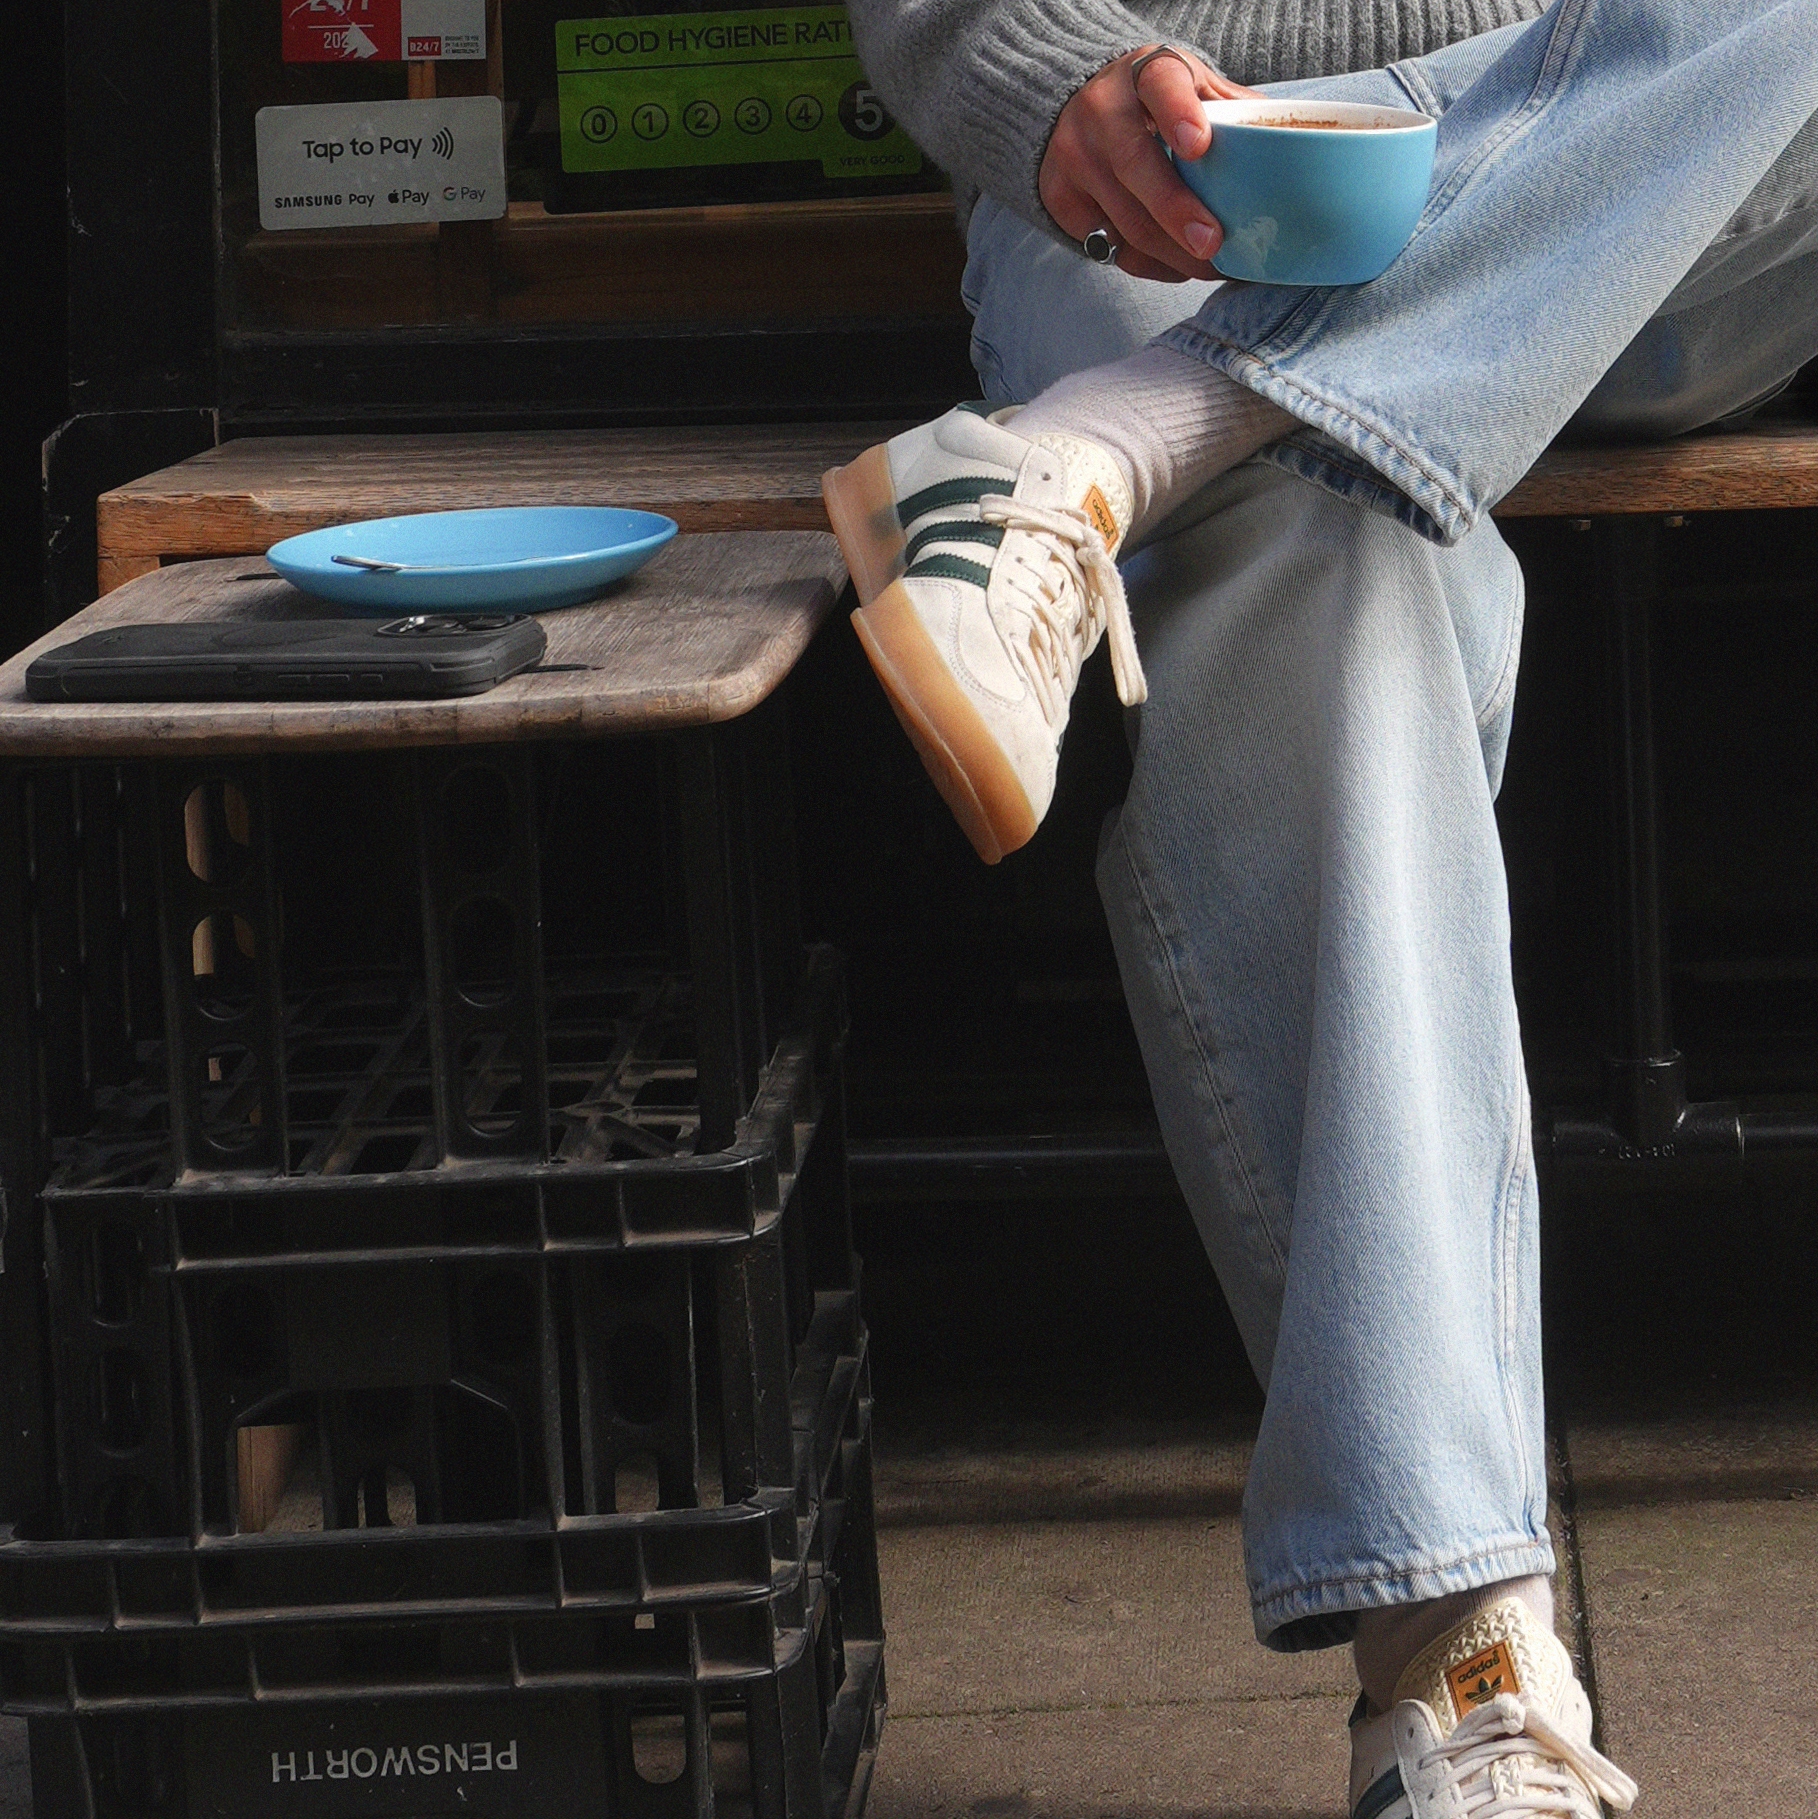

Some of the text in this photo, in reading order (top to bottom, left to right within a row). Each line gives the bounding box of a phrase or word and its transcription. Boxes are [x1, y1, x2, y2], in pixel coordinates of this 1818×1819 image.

[323, 31, 353, 50] 202
[575, 32, 660, 57] FOOD
[668, 24, 786, 51] HYGIENE
[591, 90, 883, 136] 0 1 2 3 4 5
[302, 136, 423, 164] Tap to Pay
[840, 154, 905, 166] VERY GOOD
[274, 193, 376, 209] SAMSUNG Pay
[402, 189, 430, 206] Pay
[461, 186, 487, 203] Pay
[1457, 1649, 1500, 1684] adidas
[271, 1739, 518, 1783] PENSWORTH
